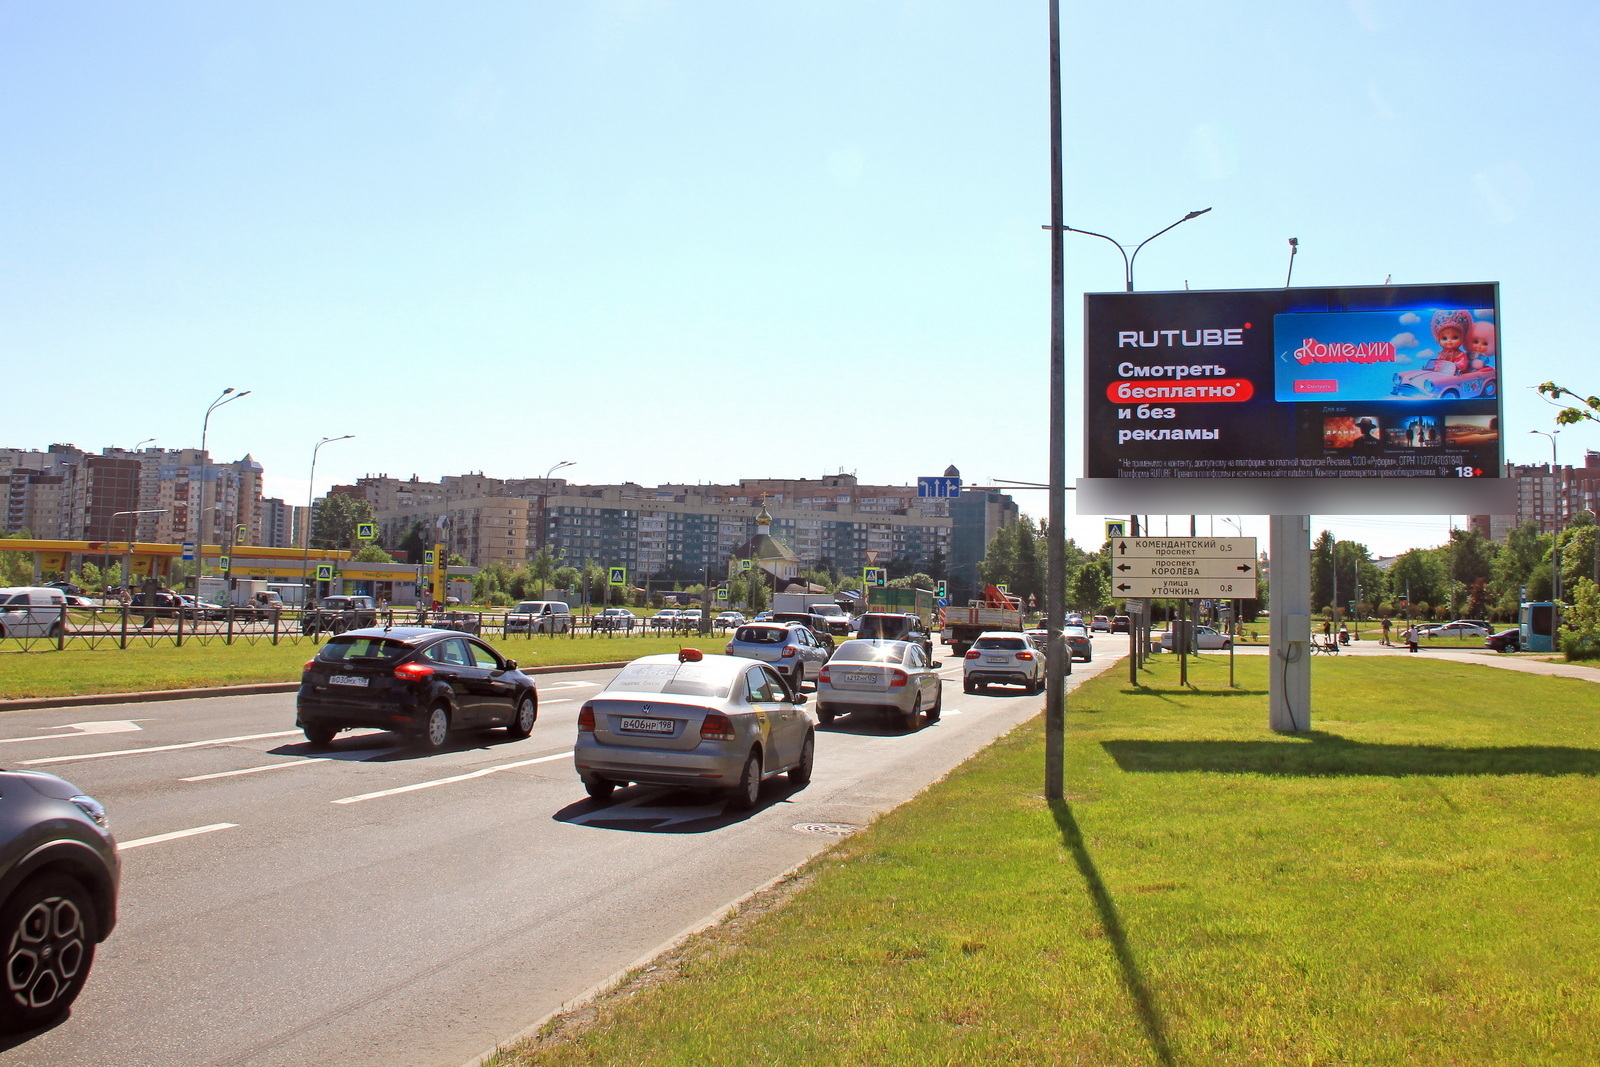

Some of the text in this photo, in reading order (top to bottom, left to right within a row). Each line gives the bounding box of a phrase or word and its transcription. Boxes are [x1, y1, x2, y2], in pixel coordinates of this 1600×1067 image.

[1118, 328, 1244, 348] RUTUBE
[1293, 338, 1392, 361] Комедии
[1118, 362, 1226, 380] Смотреть
[1118, 404, 1176, 420] и без
[1118, 428, 1220, 445] рекламы
[1455, 466, 1484, 478] 18+
[1135, 540, 1216, 549] КОМЕНДАНТСКИЙ
[1151, 566, 1200, 576] КОРОЛЁВА
[1151, 587, 1200, 596] УТОЧКИНА
[623, 719, 672, 730] В406НР 198
